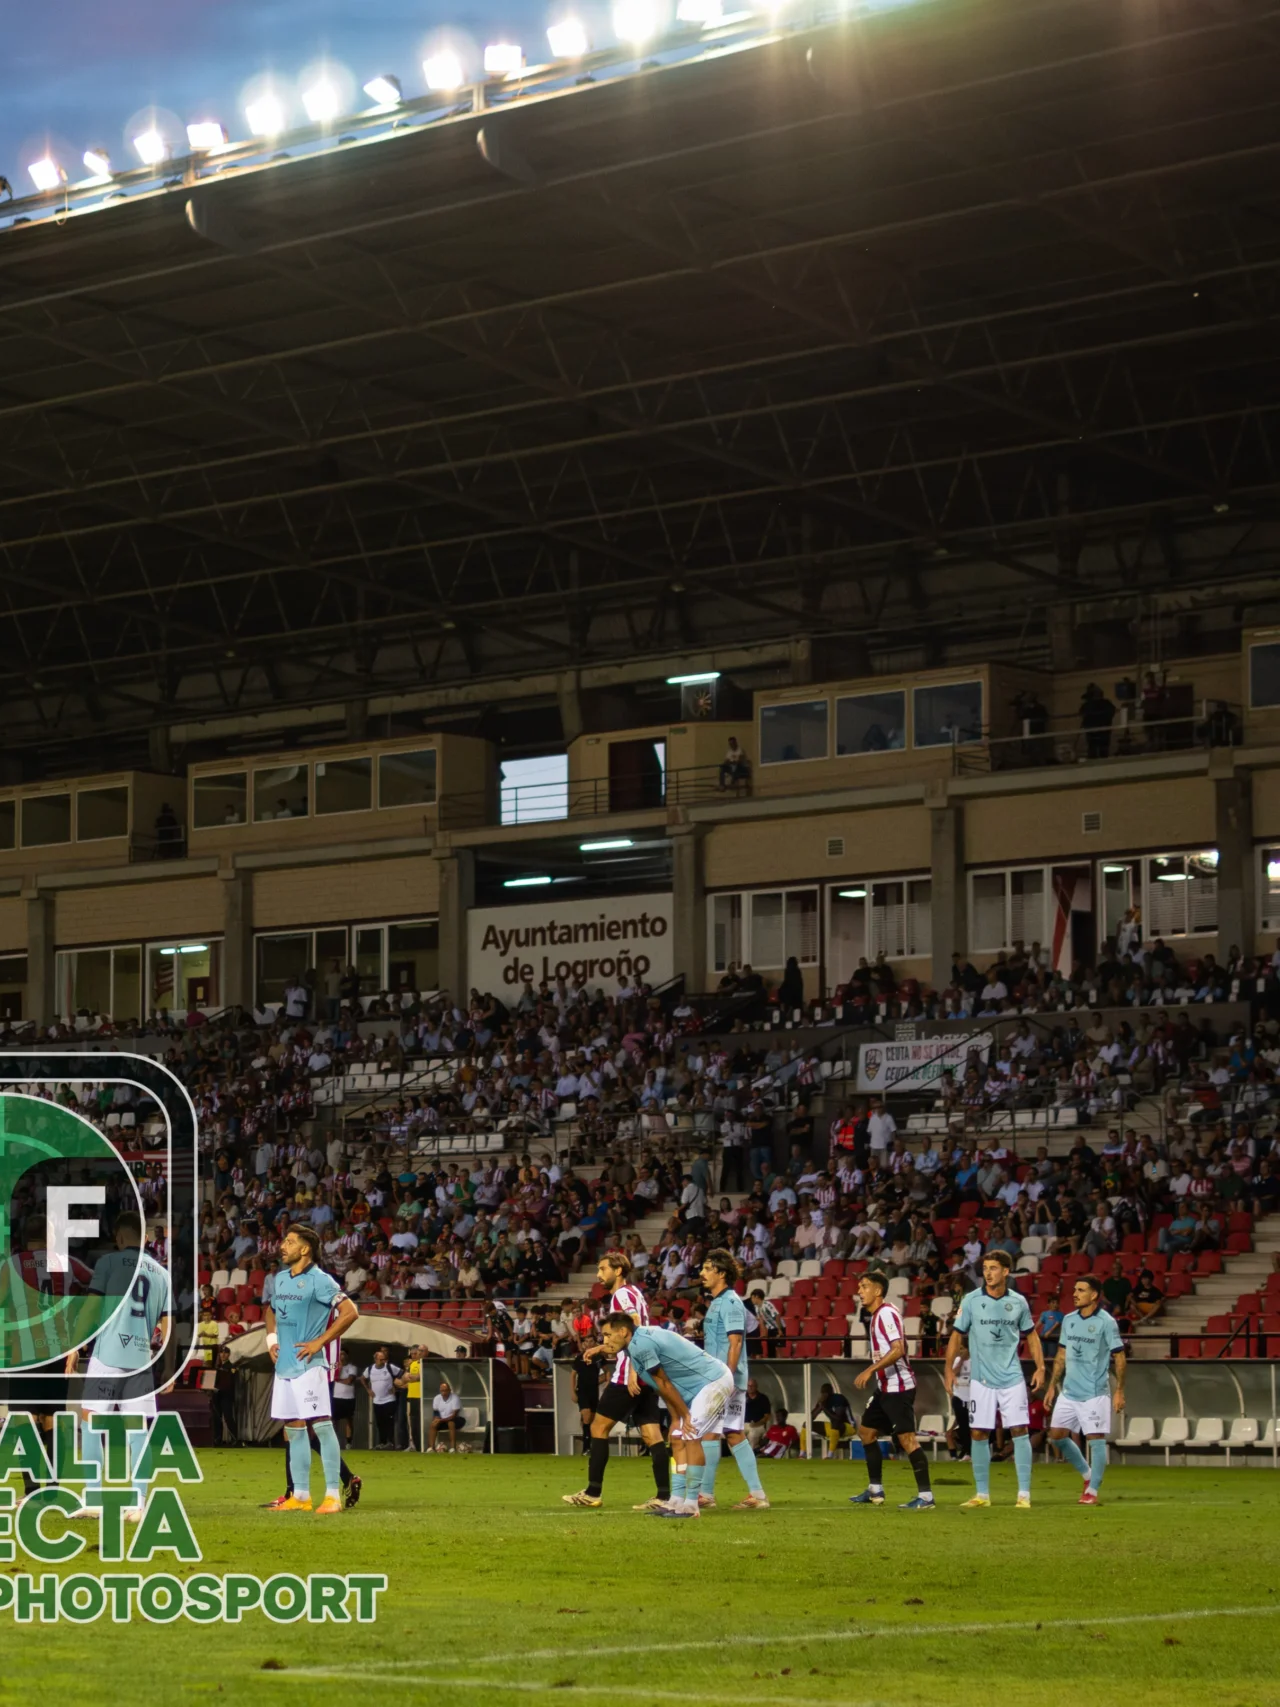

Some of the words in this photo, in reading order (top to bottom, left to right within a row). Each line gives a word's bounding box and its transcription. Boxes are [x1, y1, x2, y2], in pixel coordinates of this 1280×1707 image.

[481, 912, 668, 957] Ayuntamiento
[503, 957, 534, 985] de
[542, 949, 650, 986] Logroño
[886, 1046, 910, 1061] CEUTA
[131, 1275, 150, 1318] 9
[980, 1318, 1015, 1327] telepizza
